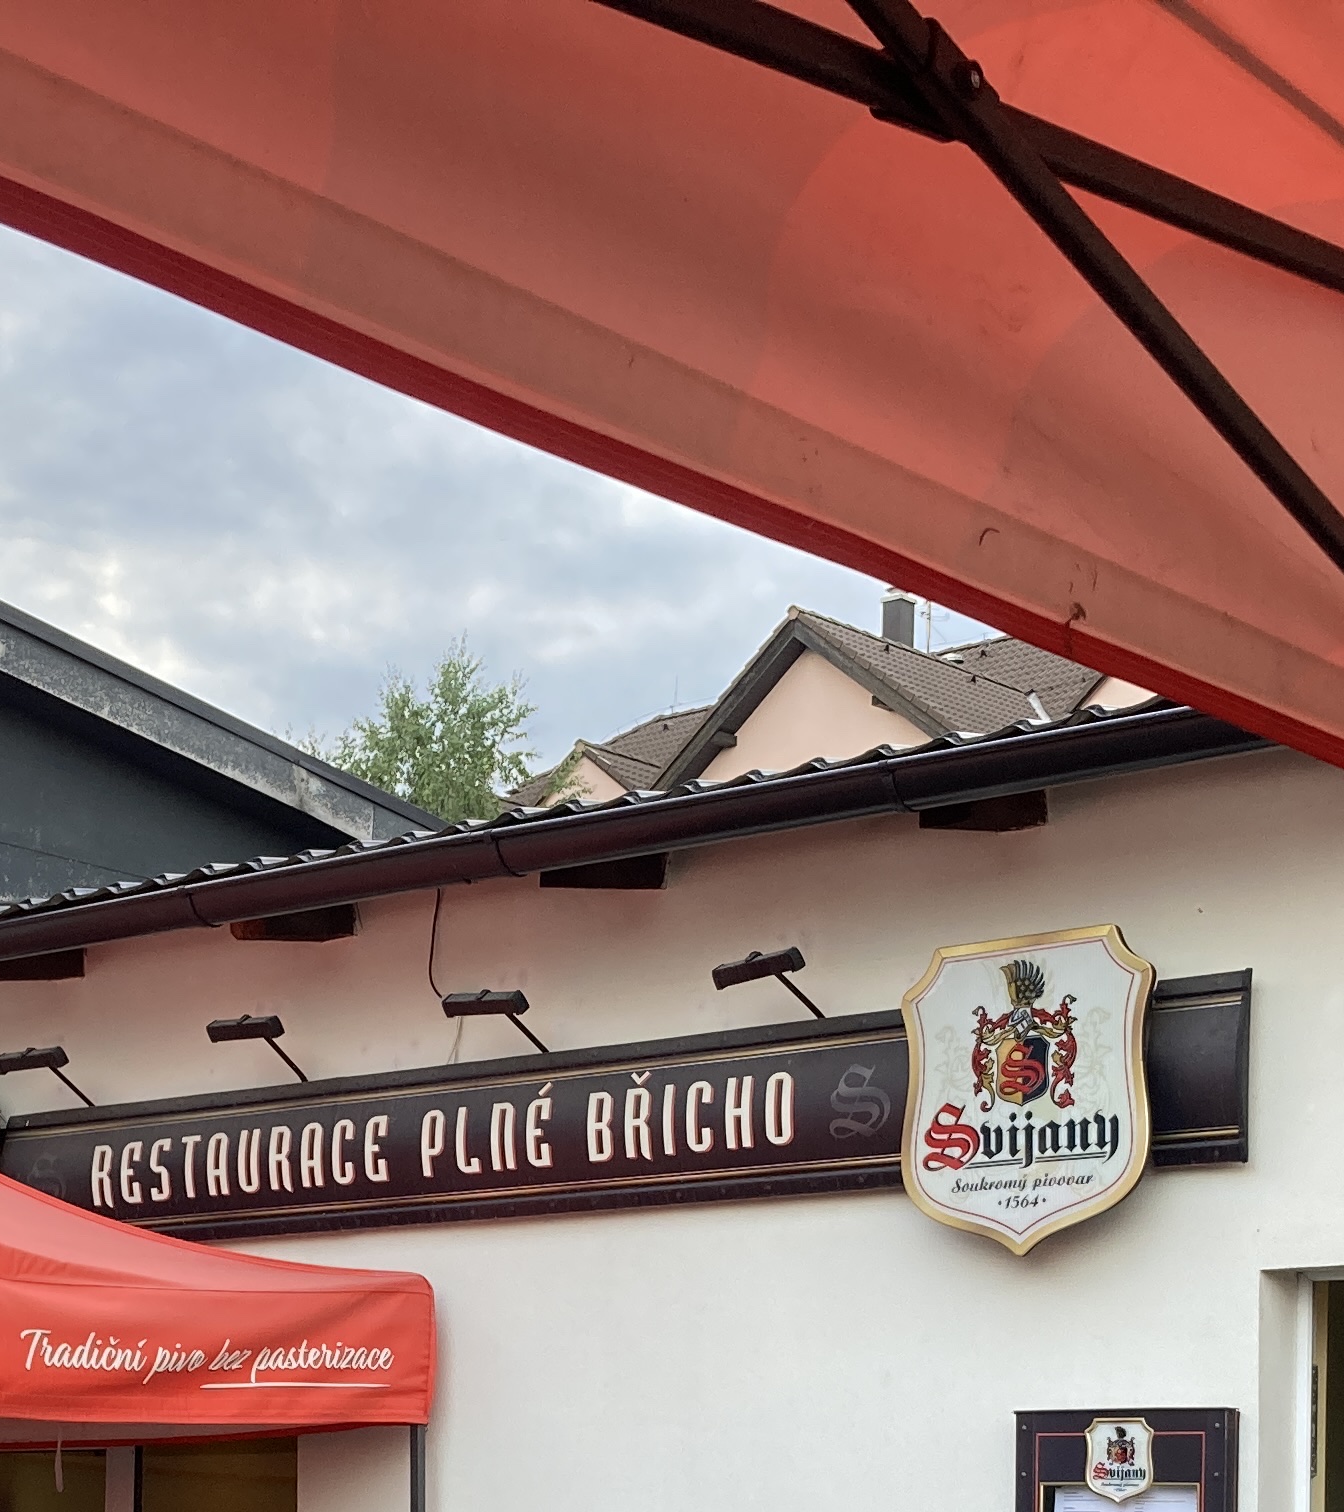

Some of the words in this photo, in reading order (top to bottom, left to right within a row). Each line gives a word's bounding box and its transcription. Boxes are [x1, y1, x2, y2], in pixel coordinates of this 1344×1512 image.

[90, 1114, 390, 1209] RESTAURACE
[420, 1082, 554, 1178] PLNÉ
[586, 1071, 795, 1163] BŘICHO
[922, 1102, 1120, 1172] Svijany
[951, 1174, 1028, 1194] Soukromý
[20, 1328, 148, 1372] Tradiční
[142, 1342, 208, 1385] pivo
[207, 1338, 251, 1372] bez
[250, 1338, 396, 1385] pasterizace
[1092, 1461, 1146, 1481] Svijany
